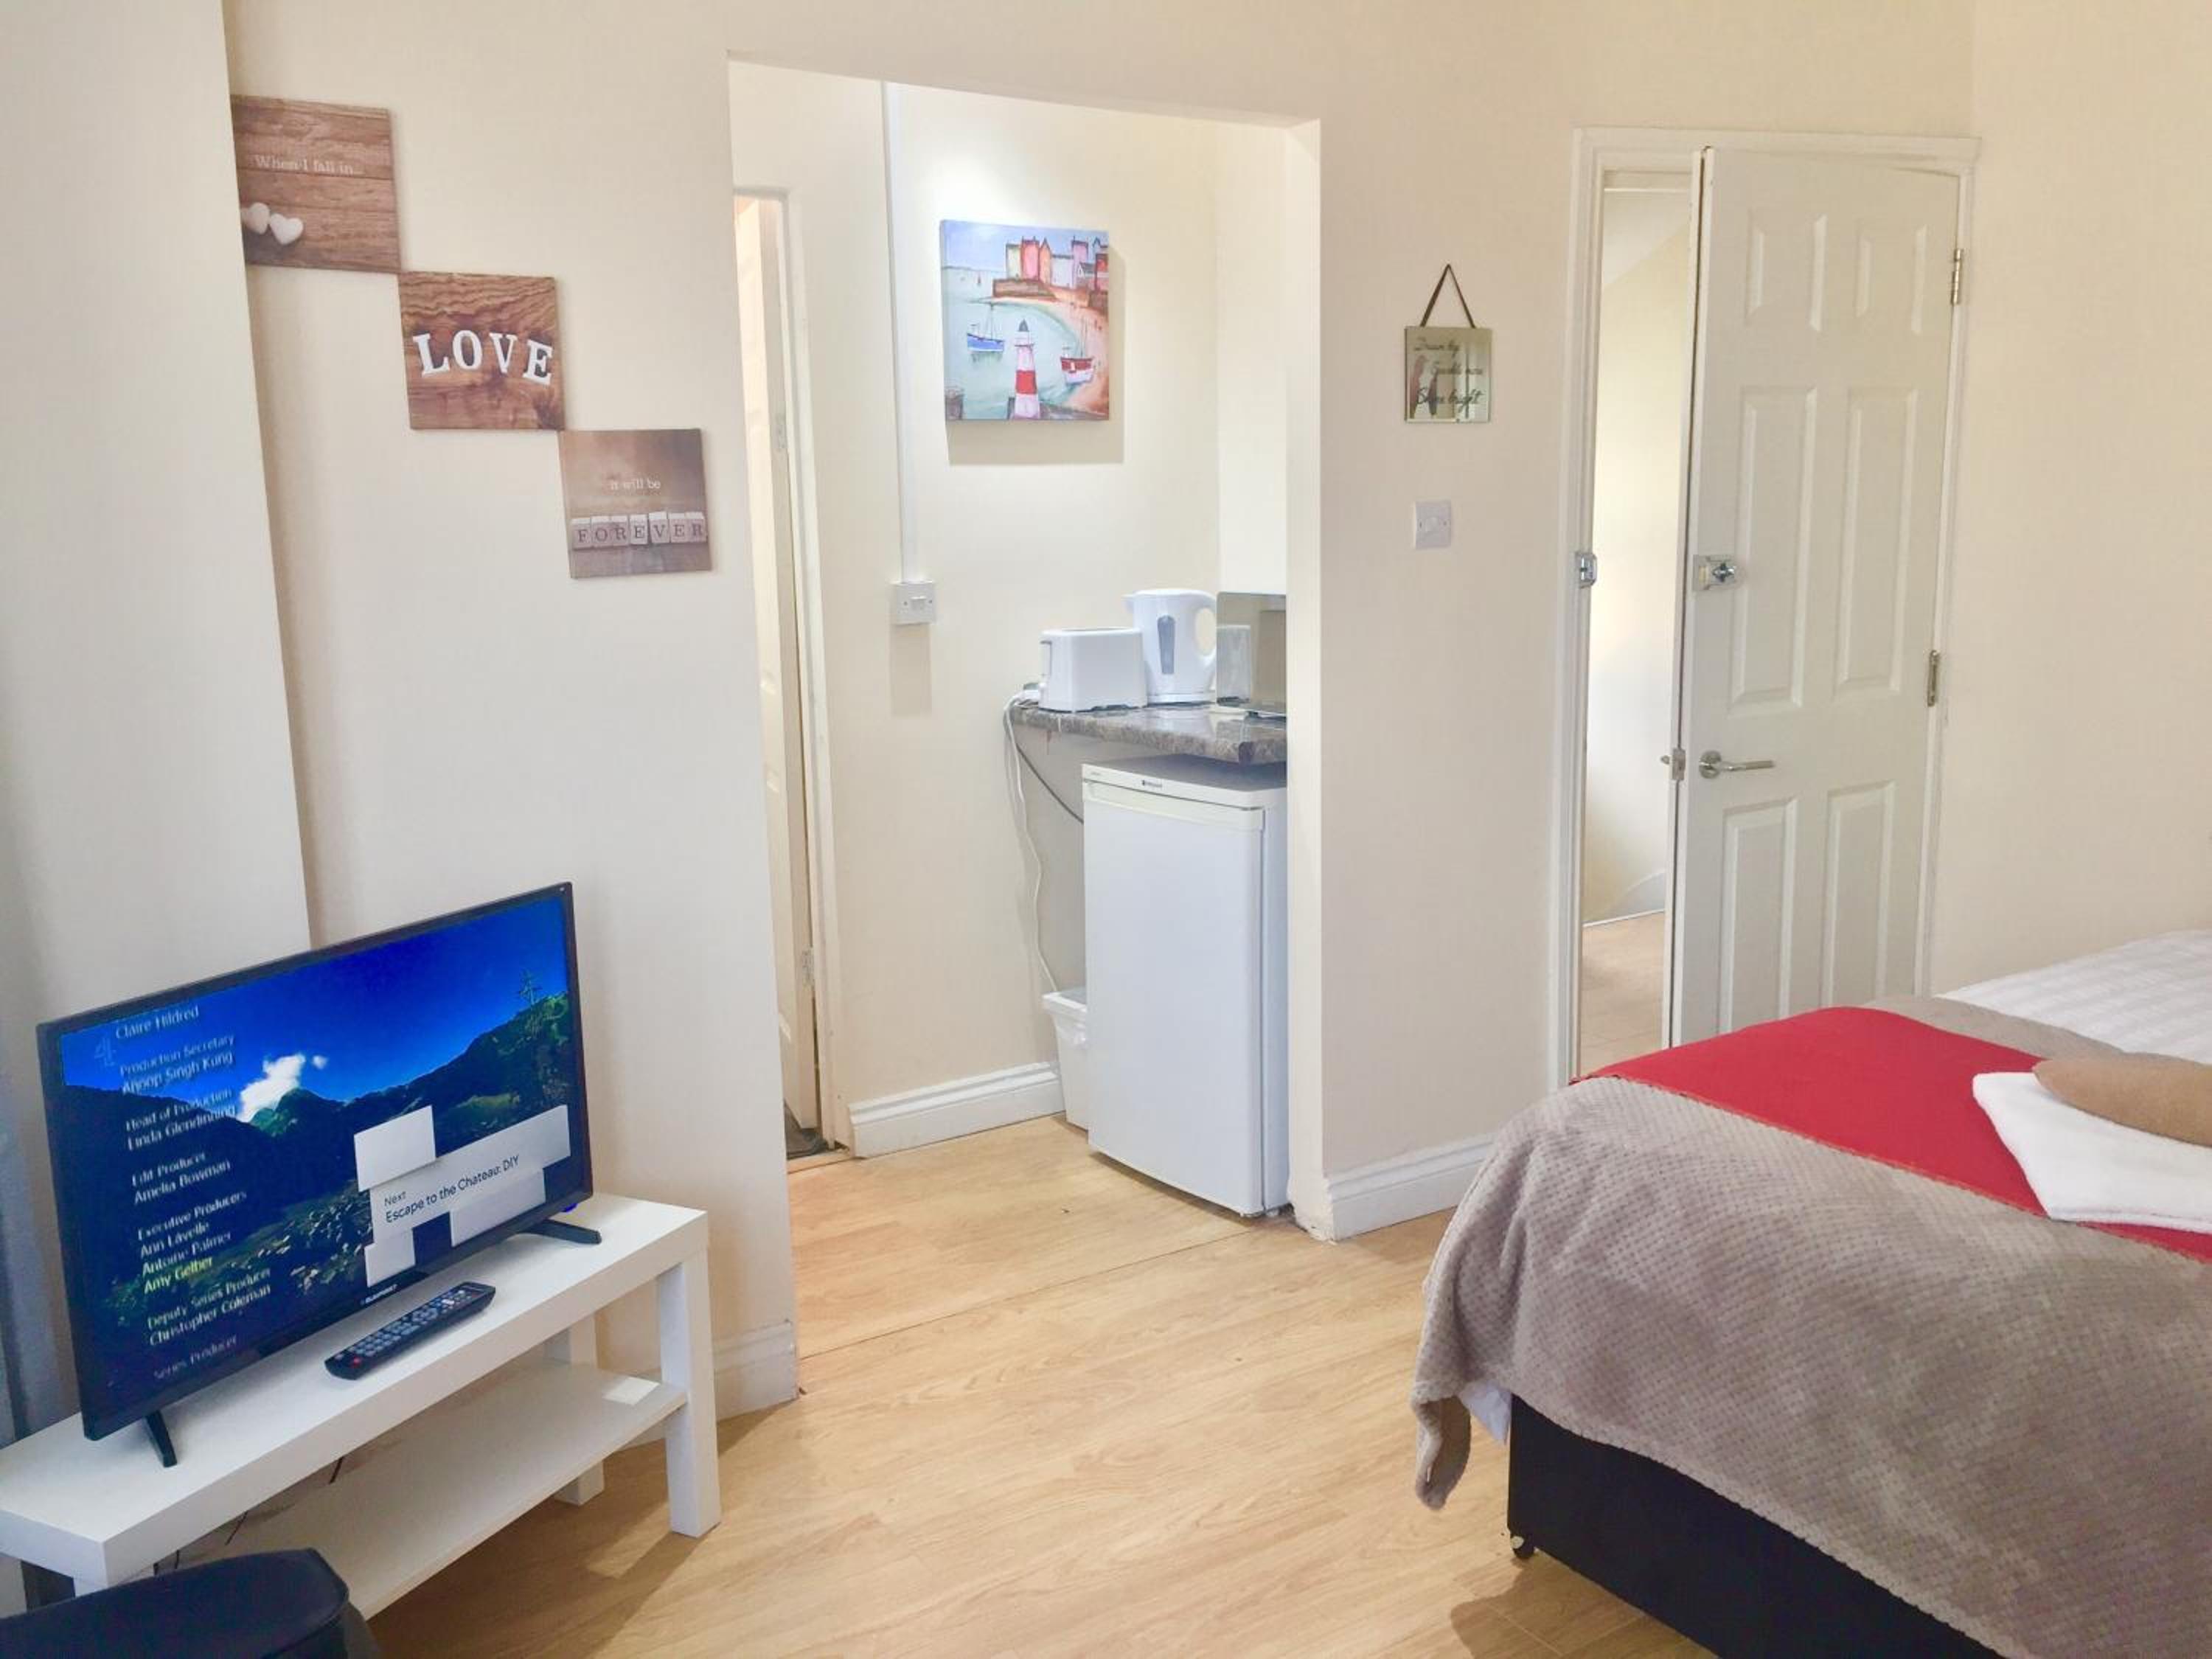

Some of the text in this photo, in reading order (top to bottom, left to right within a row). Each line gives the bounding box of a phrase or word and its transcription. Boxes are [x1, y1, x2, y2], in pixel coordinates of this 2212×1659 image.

[413, 330, 552, 385] LOVE
[647, 478, 661, 490] be
[577, 523, 704, 543] FOREVER
[116, 1019, 151, 1040] Claire
[184, 1034, 235, 1057] Secretary
[384, 1191, 406, 1206] Next
[386, 1200, 424, 1223] Escape
[425, 1194, 438, 1205] to
[439, 1185, 456, 1200] the
[503, 1155, 520, 1171] DIY
[194, 1192, 247, 1218] Producers
[140, 1239, 164, 1259] Ann
[144, 1274, 171, 1294] Amy
[226, 1267, 271, 1295] Producer
[150, 1308, 218, 1346] Christopher
